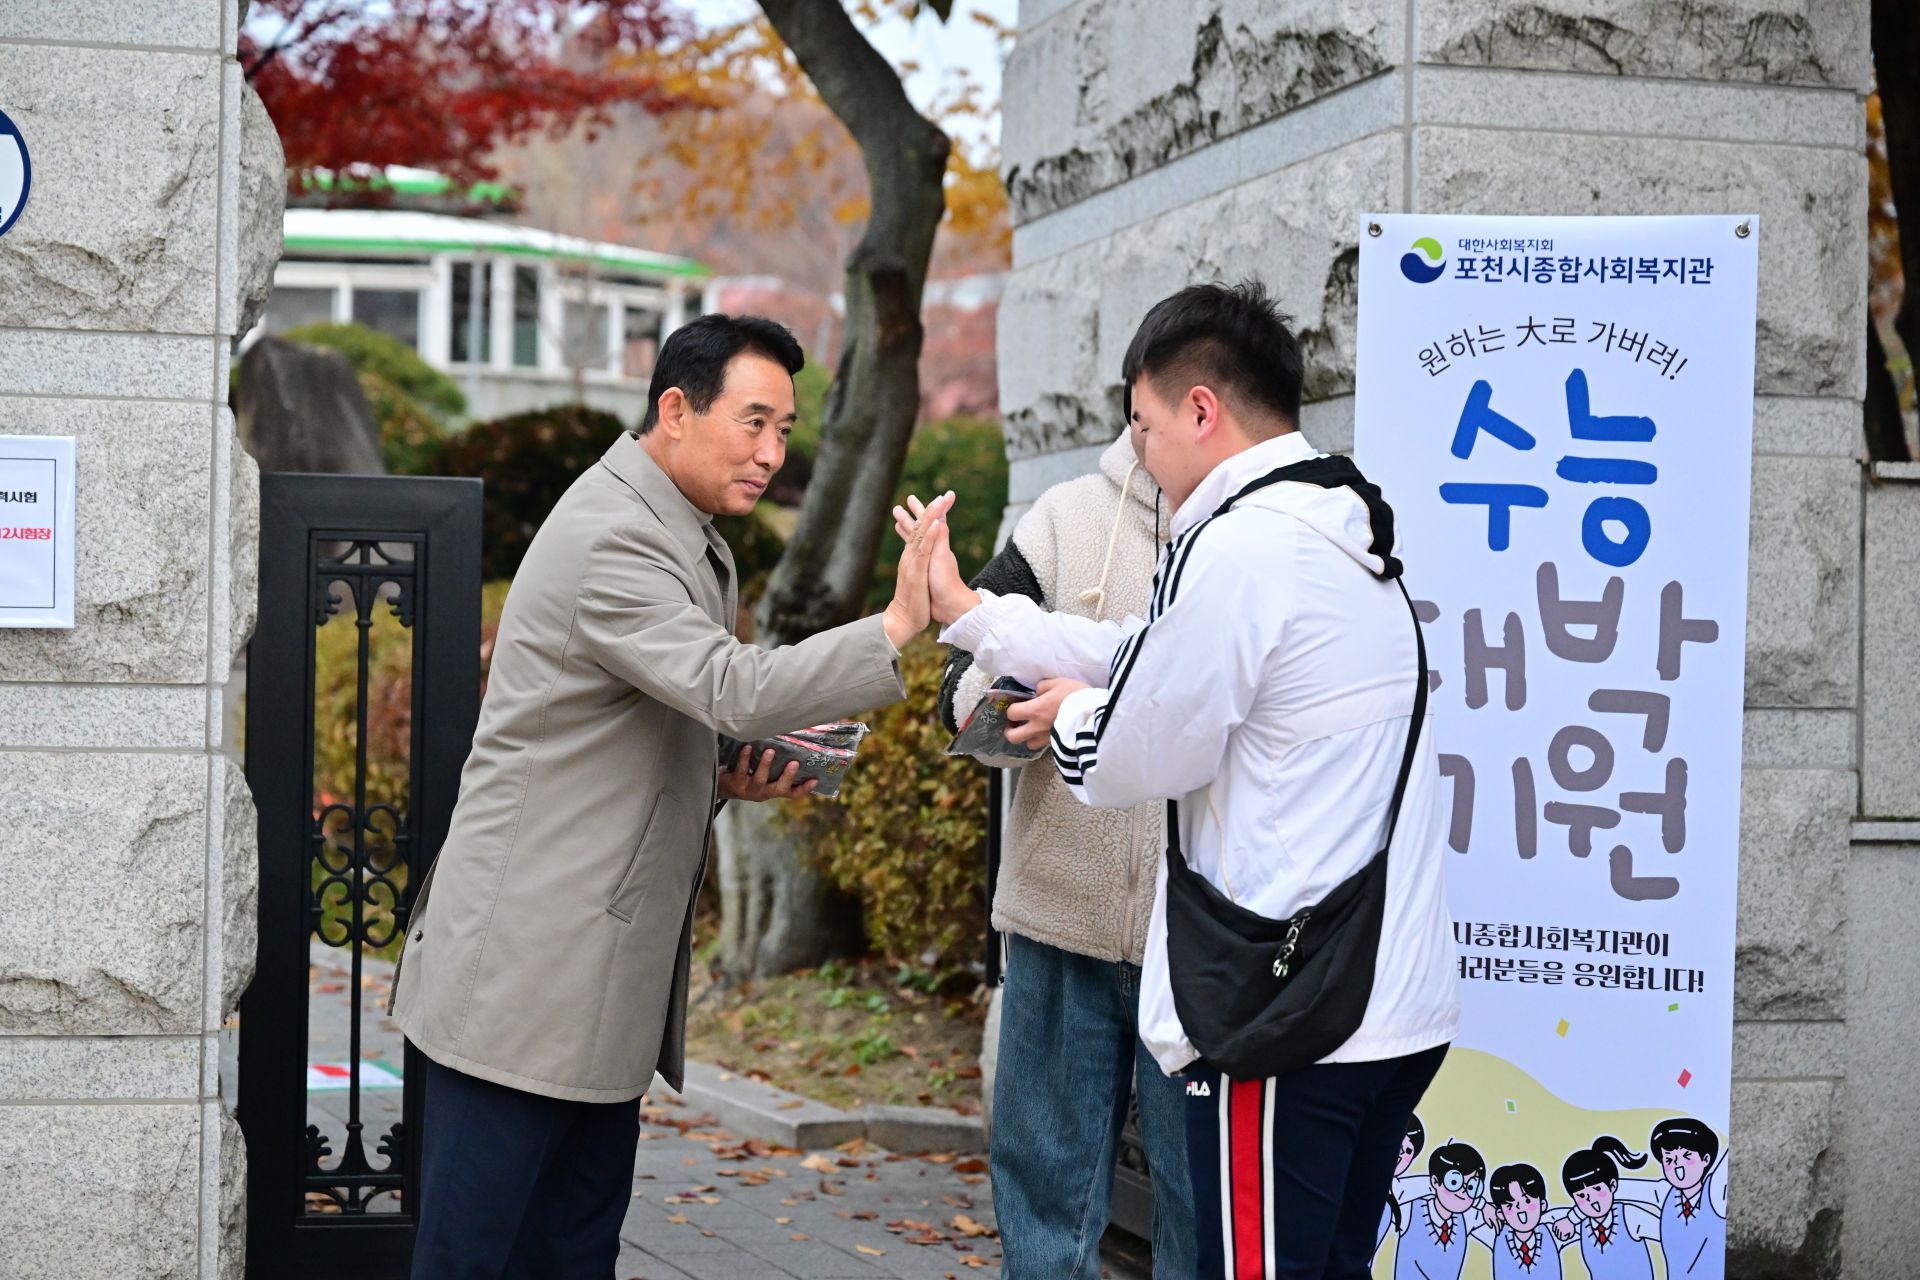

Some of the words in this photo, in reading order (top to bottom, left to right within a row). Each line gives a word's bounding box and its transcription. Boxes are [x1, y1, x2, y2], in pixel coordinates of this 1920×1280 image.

[1458, 238, 1554, 253] 대한사회복지회
[1454, 256, 1714, 284] 포천시종합사회복지관
[1418, 323, 1505, 377] 원하는
[1515, 316, 1577, 347] 大로
[1587, 321, 1688, 381] 가버려!
[1439, 368, 1658, 567] 수능
[1438, 725, 1689, 901] 기원
[1453, 921, 1669, 957] 시종합사회복지관이
[1572, 963, 1704, 993] 응원합니다!
[1186, 1081, 1211, 1096] FILA
